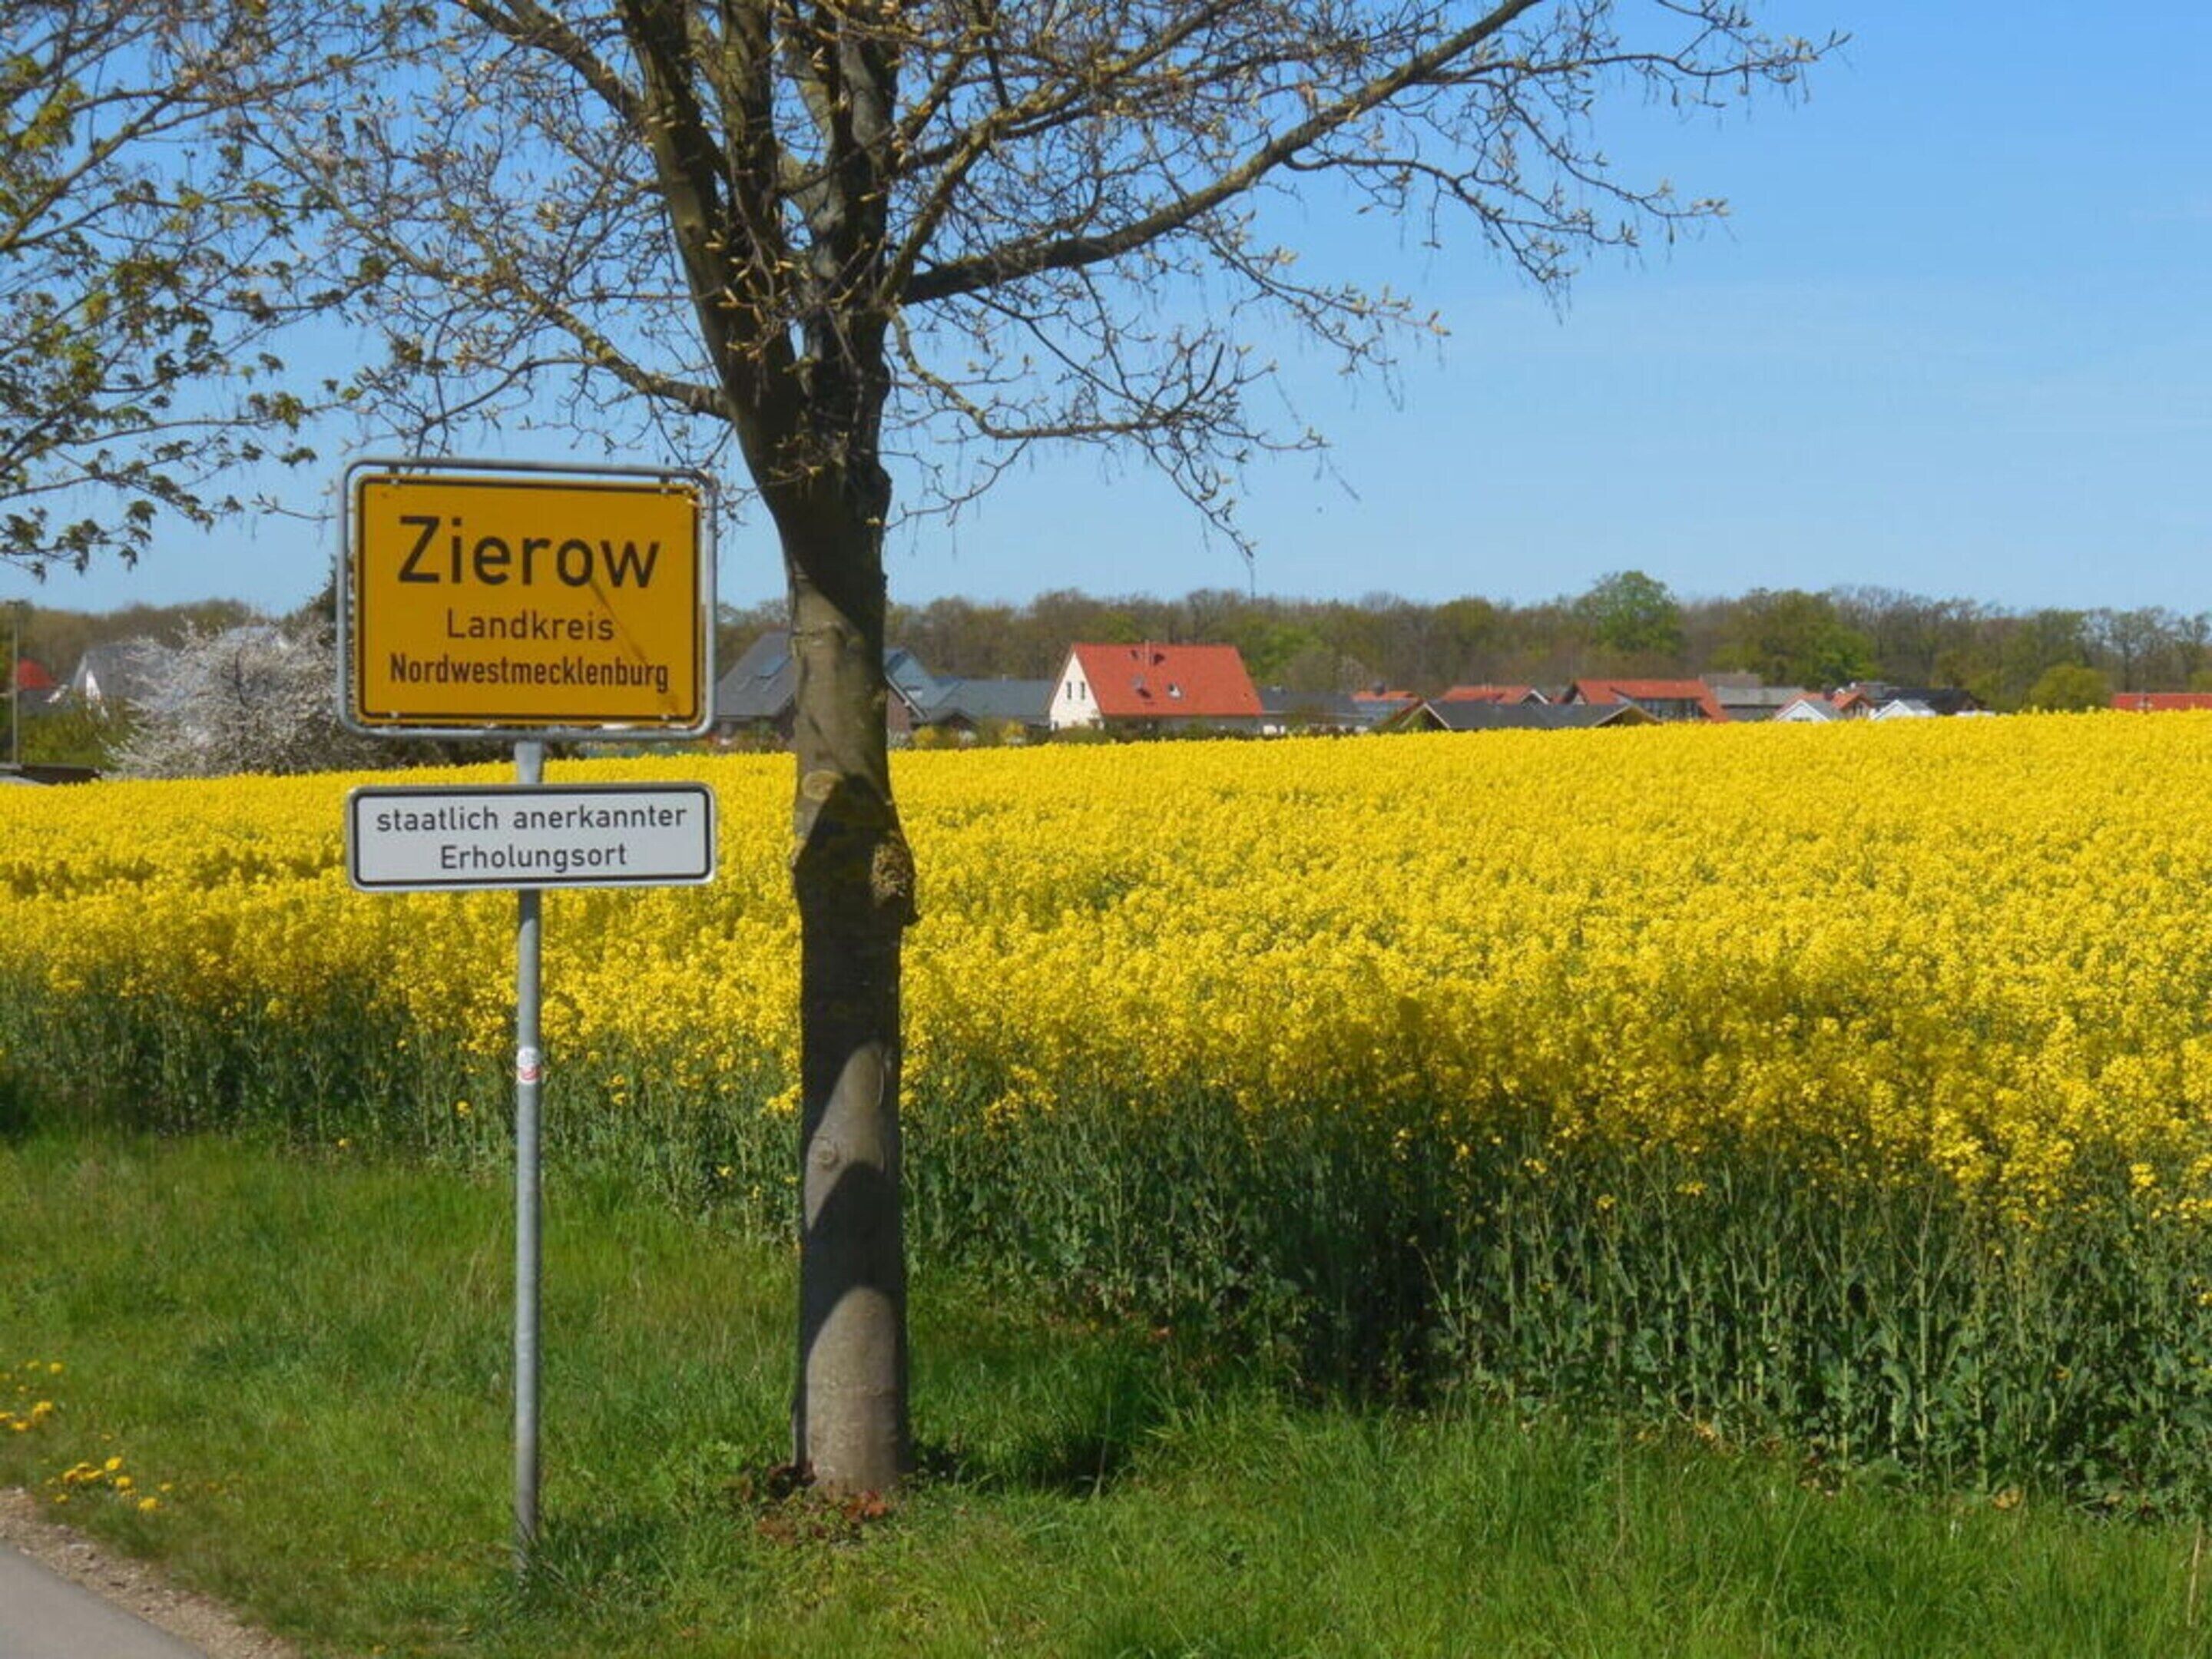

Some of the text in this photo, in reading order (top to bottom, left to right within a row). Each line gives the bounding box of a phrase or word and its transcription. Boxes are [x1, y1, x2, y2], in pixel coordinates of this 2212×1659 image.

[398, 515, 661, 588] Zierow
[447, 608, 614, 641] Landkreis
[389, 652, 669, 694] Nordwestmecklenburg
[376, 804, 687, 832] staatlich anerkannter
[440, 843, 628, 873] Erholungsort
